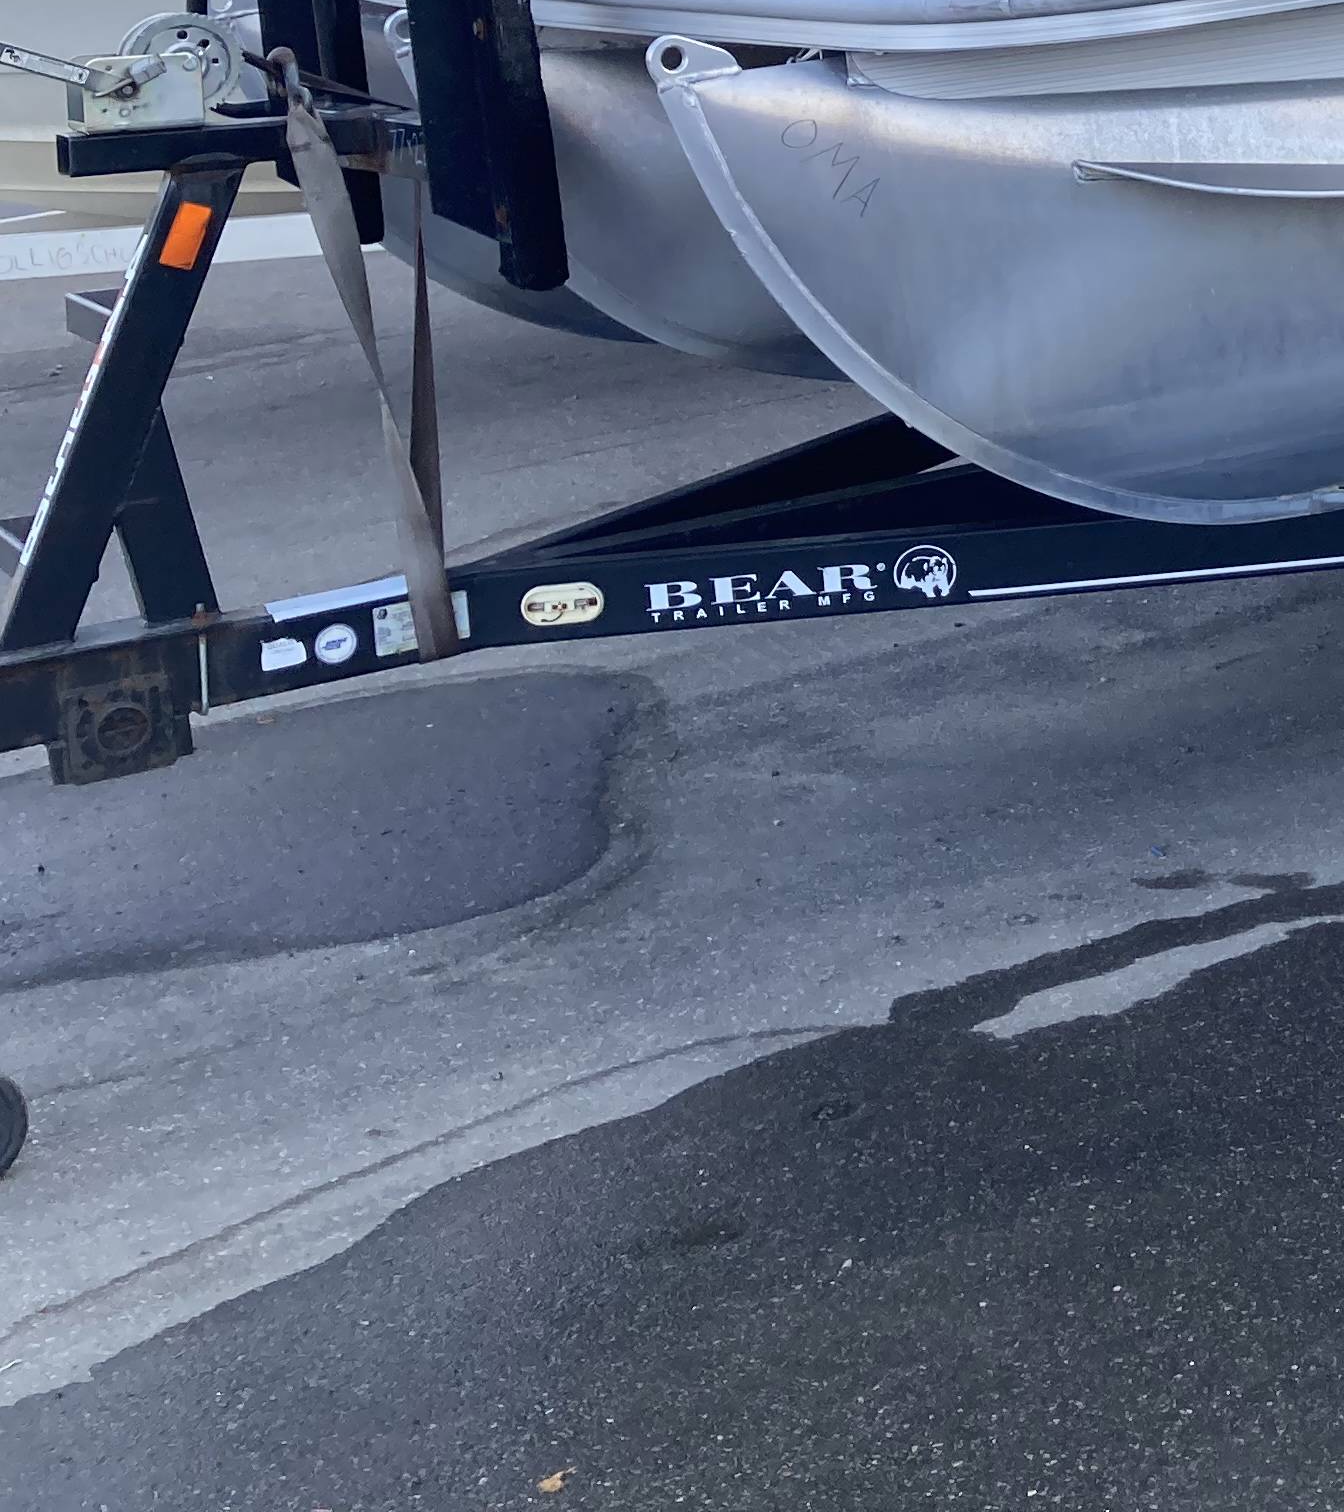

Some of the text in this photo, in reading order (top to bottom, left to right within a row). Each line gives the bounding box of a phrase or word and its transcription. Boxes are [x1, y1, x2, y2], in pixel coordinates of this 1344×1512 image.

[644, 564, 878, 612] BEAR
[651, 592, 876, 623] TRAILER MFG
